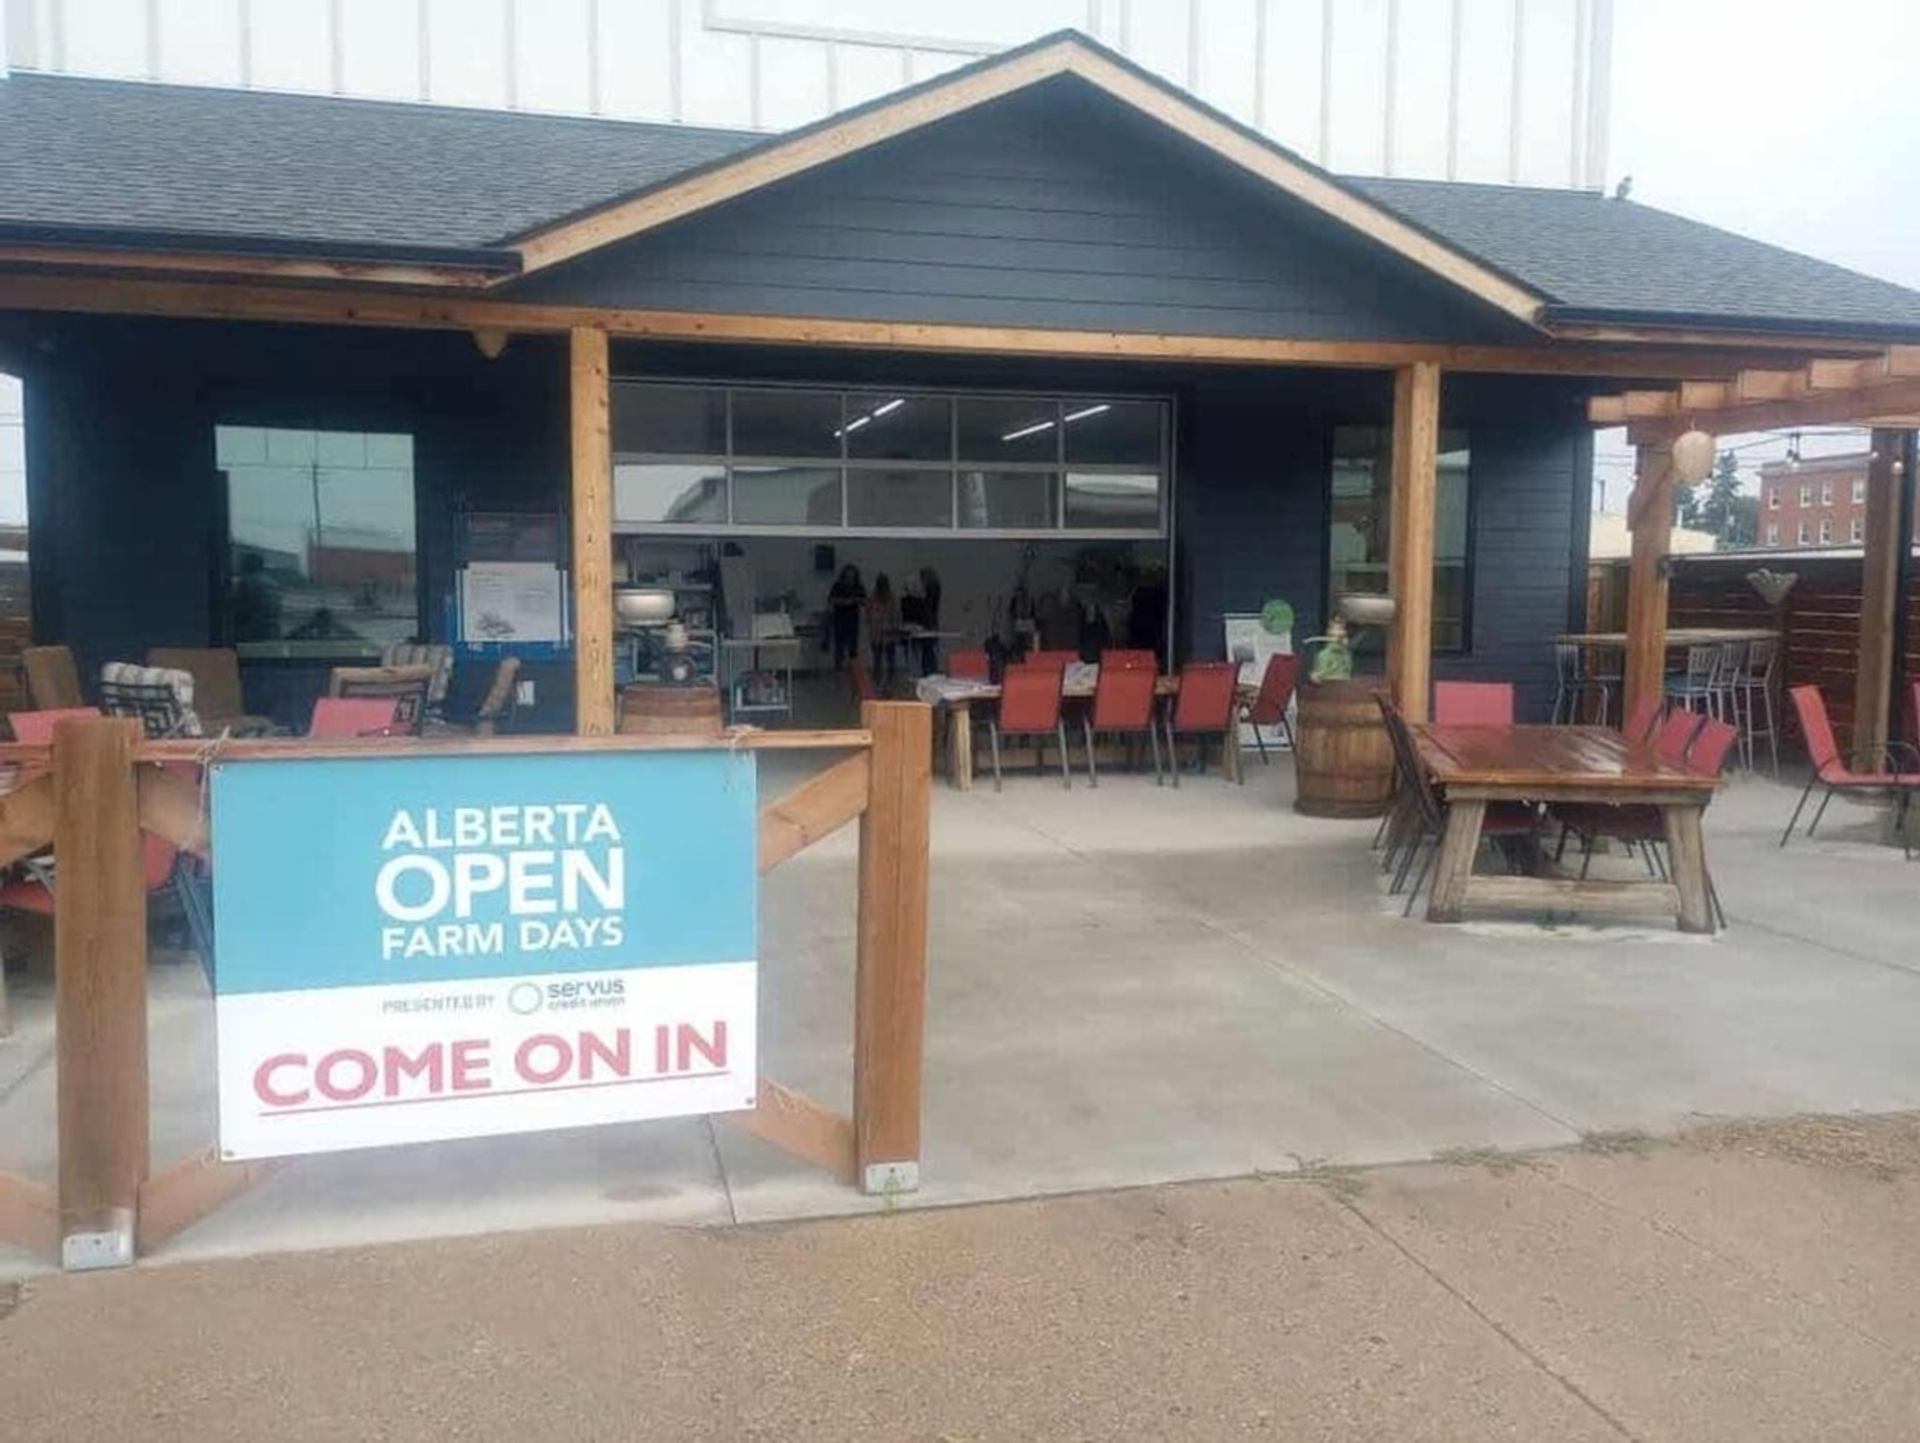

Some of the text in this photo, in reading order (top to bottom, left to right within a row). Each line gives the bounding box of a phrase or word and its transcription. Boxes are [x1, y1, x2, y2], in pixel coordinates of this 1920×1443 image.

[382, 804, 622, 850] ALBERTA
[375, 848, 625, 922] OPEN
[381, 915, 624, 961] FARM DAYS
[546, 978, 626, 999] servus
[253, 1020, 728, 1107] COME ON IN
